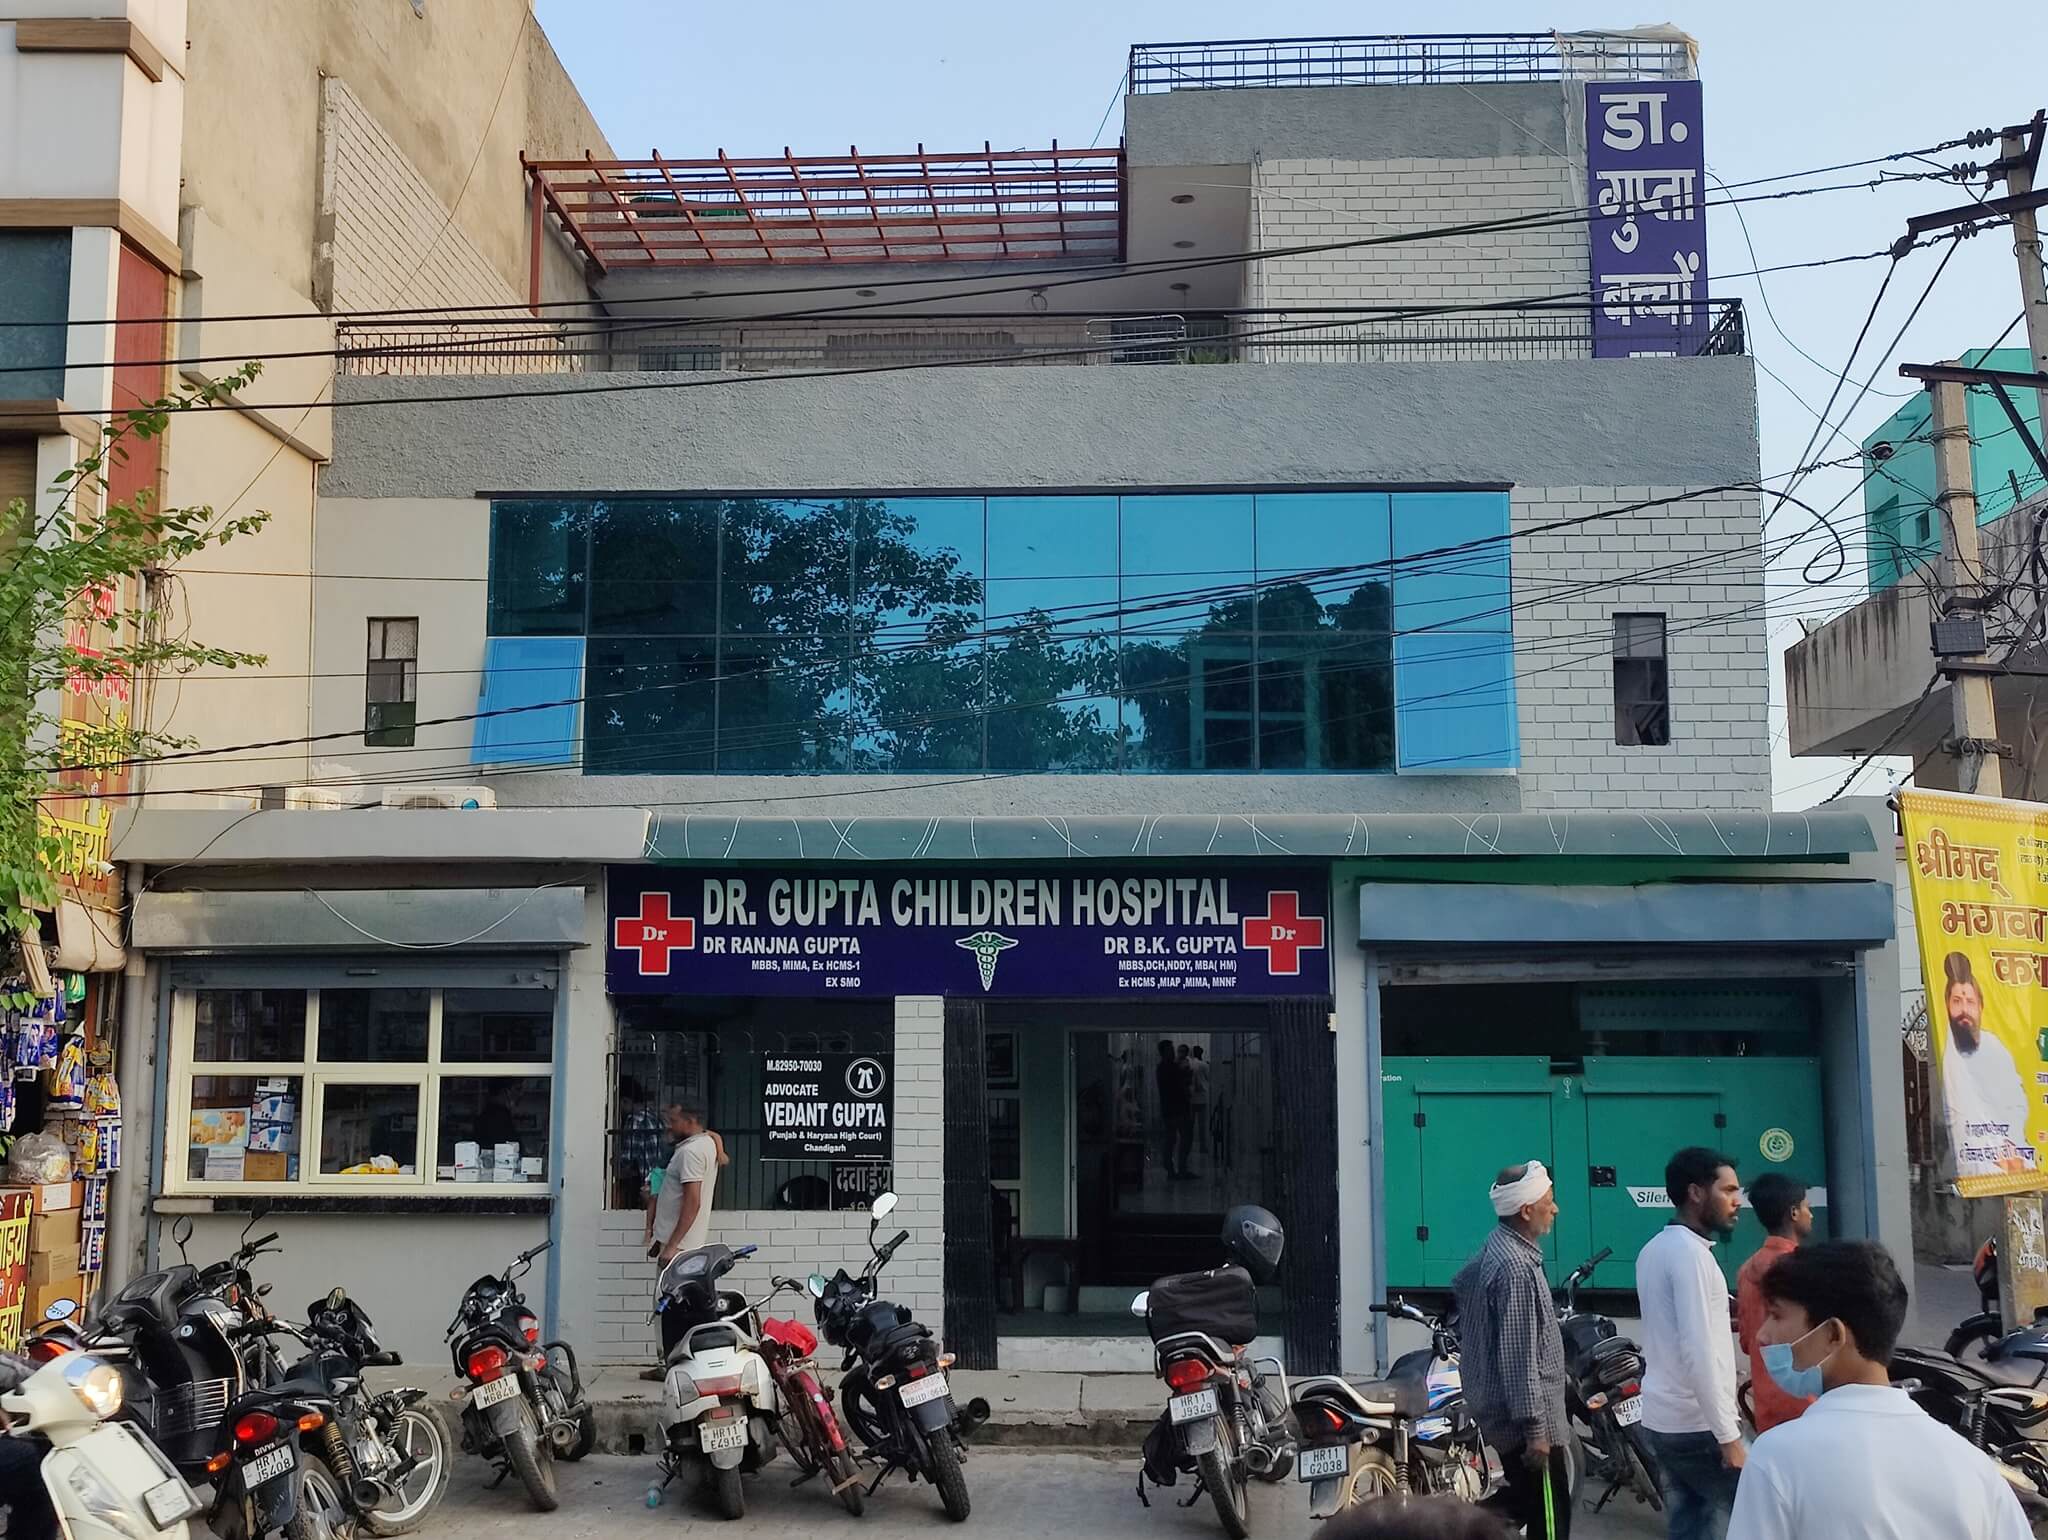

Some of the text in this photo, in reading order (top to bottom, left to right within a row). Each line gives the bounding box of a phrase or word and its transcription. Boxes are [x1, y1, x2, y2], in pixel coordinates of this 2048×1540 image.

[1599, 93, 1688, 151] डा.
[1596, 168, 1697, 254] गुप्ता
[1916, 829, 2011, 898] श्रीमद्
[703, 878, 1239, 927] DR. GUPTA CHILDREN HOSPITAL
[641, 925, 668, 942] Dr
[1270, 925, 1296, 941] Dr
[703, 936, 861, 954] DR RANJNA GUPTA
[1103, 936, 1238, 954] DR B.K. GUPTA
[751, 960, 861, 972] MBBS, MIMA, Ex HCMS-1
[825, 977, 861, 988] EX SMO
[1118, 977, 1130, 988] Ex
[1131, 977, 1156, 988] HCMS
[1212, 977, 1237, 988] MNNF
[766, 1059, 823, 1072] M.82950-70030
[765, 1083, 819, 1096] ADVOCATE
[764, 1101, 887, 1128] VEDANT GUPTA
[768, 1130, 882, 1142] (Punjab & Haryana High Court)
[804, 1143, 847, 1154] Chandigarh
[483, 1377, 509, 1395] HR11
[1180, 1392, 1206, 1408] HR11
[1182, 1401, 1213, 1418] J9349
[713, 1425, 738, 1440] HR11
[255, 1449, 284, 1472] HR11
[1313, 1447, 1339, 1462] HR11
[256, 1457, 291, 1483] J5408
[1310, 1459, 1343, 1475] G2038
